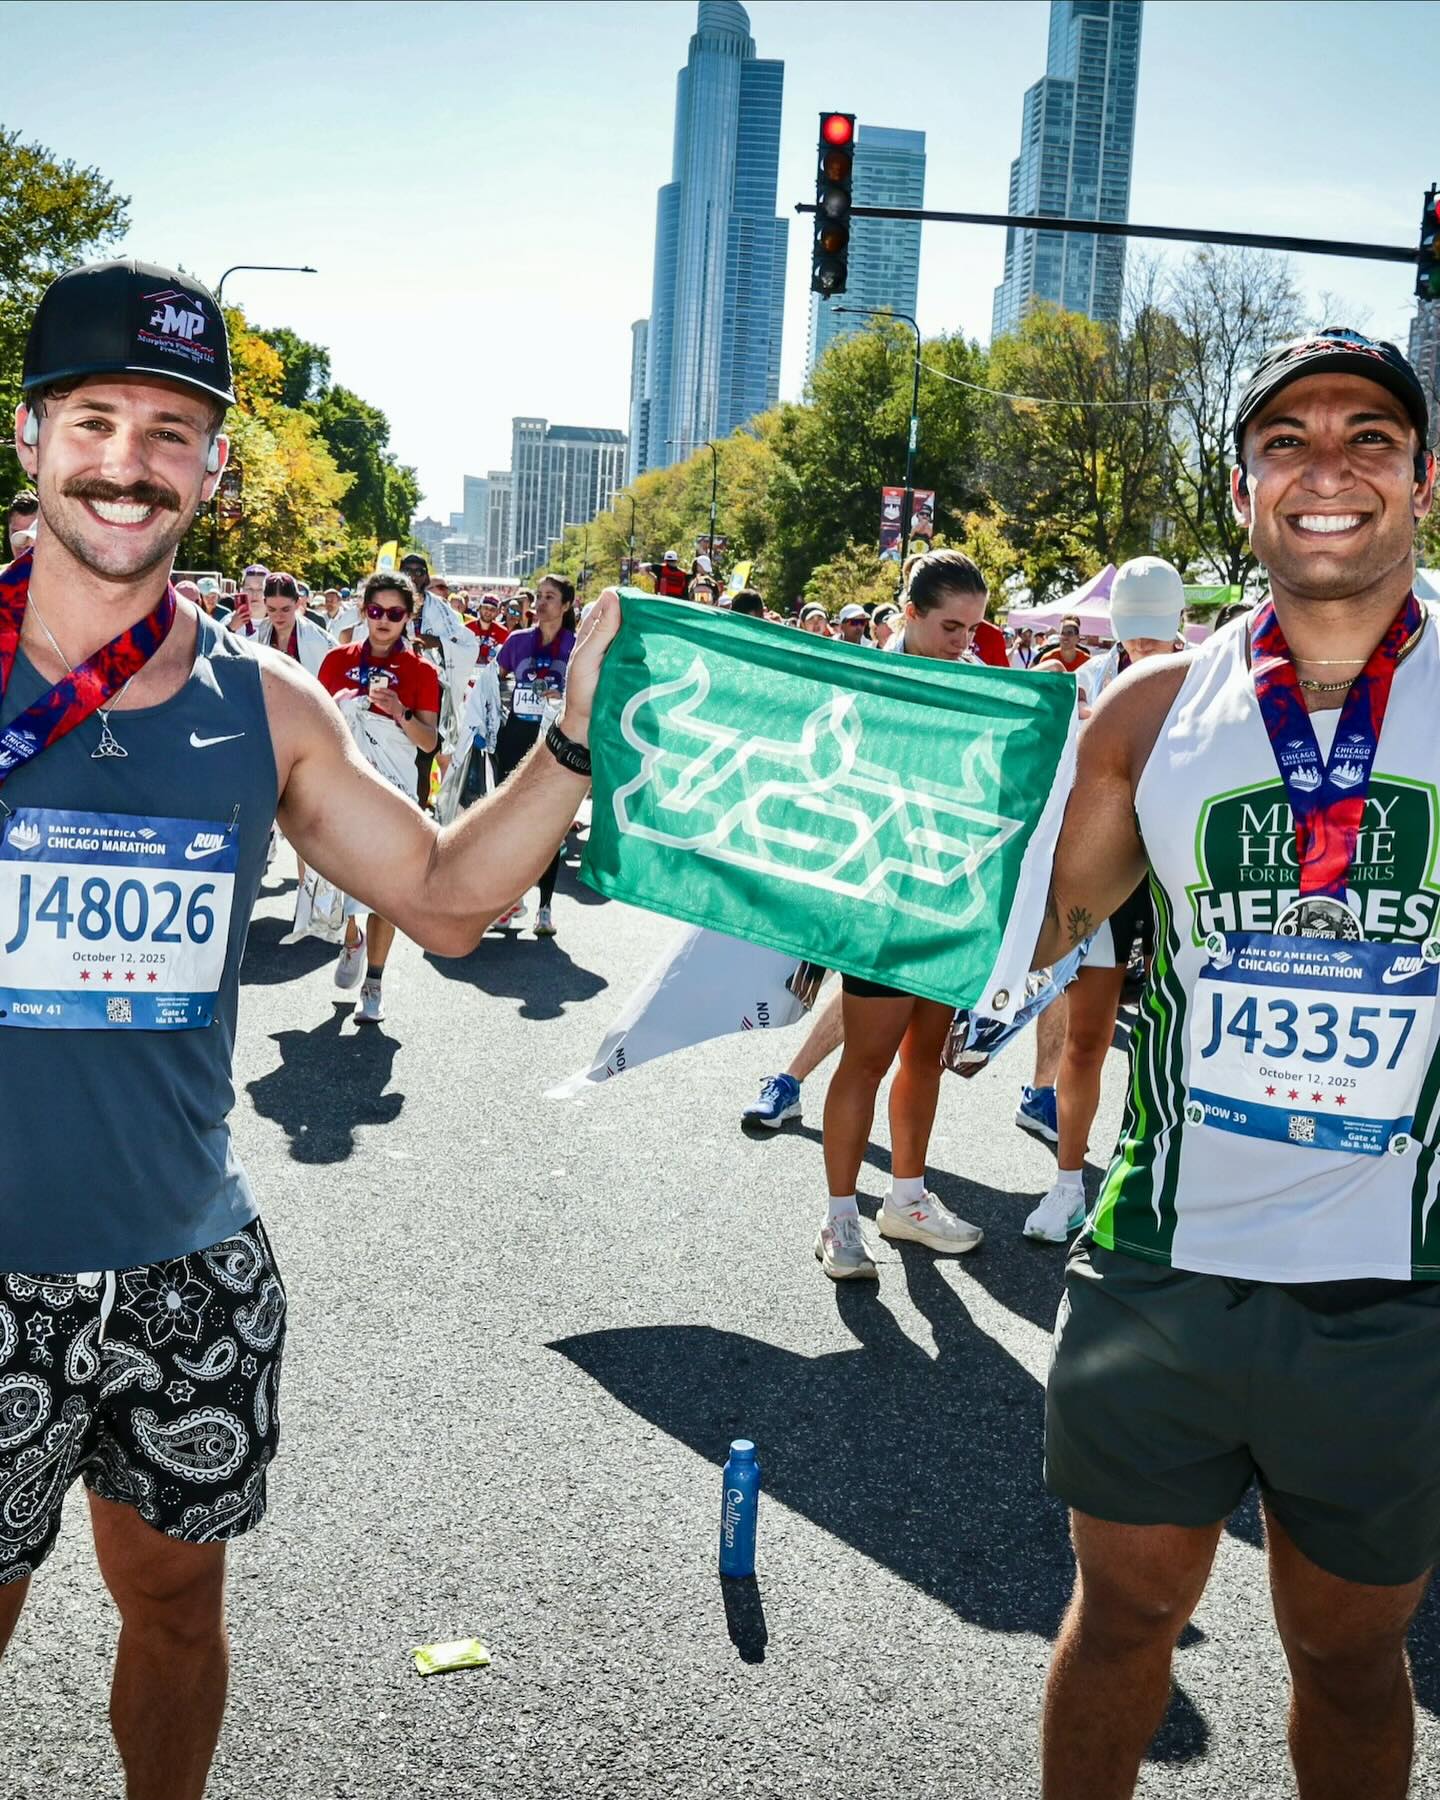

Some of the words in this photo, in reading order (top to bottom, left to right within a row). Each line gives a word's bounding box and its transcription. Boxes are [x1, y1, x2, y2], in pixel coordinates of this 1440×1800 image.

[5, 734, 34, 755] CHICAGO
[1335, 746, 1371, 755] CHICAGO
[1281, 751, 1316, 762] CHICAGO
[1283, 757, 1318, 766] MARATHON
[49, 825, 76, 834] BANK
[79, 827, 91, 835] OF
[93, 829, 136, 838] AMERICA
[47, 837, 100, 850] CHICAGO
[102, 840, 166, 855] MARATHON
[193, 833, 225, 848] RUN
[1240, 868, 1276, 882] FOR
[4, 874, 216, 954] J48026
[72, 952, 116, 963] October
[121, 953, 136, 964] 12,
[139, 954, 166, 964] 2025
[1269, 950, 1282, 958] OF
[1284, 952, 1330, 962] AMERICA
[1238, 960, 1289, 973] CHICAGO
[1293, 963, 1362, 979] MARATHON
[1392, 956, 1424, 972] RUN
[12, 1002, 43, 1015] ROW
[46, 1005, 62, 1015] 41
[161, 1008, 180, 1016] Gate
[1201, 993, 1417, 1070] J43357
[1259, 1066, 1303, 1081] October
[1308, 1074, 1323, 1086] 12,
[1328, 1076, 1357, 1088] 2025
[1204, 1104, 1230, 1120] ROW
[1233, 1110, 1247, 1124] 39
[1348, 1132, 1369, 1142] Gate
[1370, 1135, 1376, 1143] 4
[1363, 1142, 1382, 1151] Wells
[724, 1488, 744, 1548] Culligan
